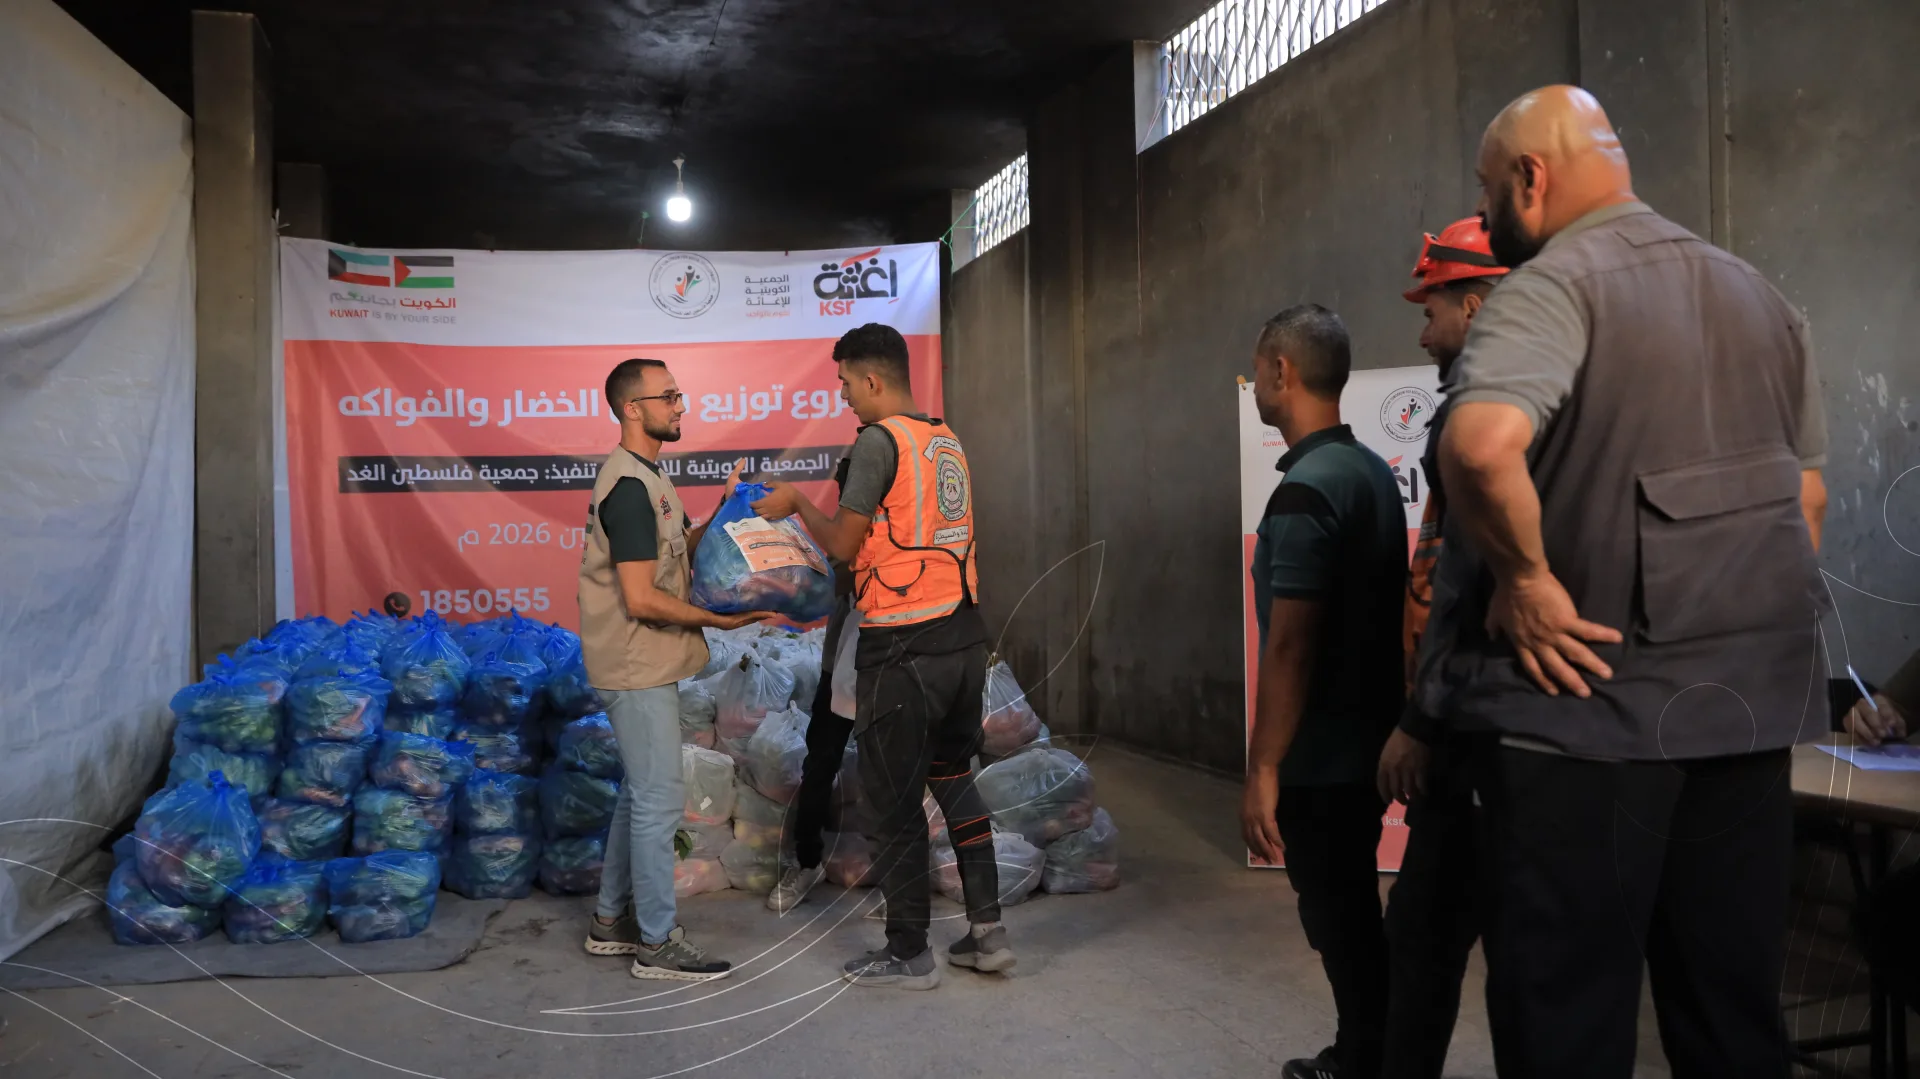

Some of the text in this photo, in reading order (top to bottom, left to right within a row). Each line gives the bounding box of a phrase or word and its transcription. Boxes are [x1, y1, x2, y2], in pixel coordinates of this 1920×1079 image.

[745, 274, 789, 285] الجمعية
[745, 285, 790, 296] الكويتية
[399, 297, 457, 311] الكويت
[745, 296, 791, 308] للإغاثة
[329, 309, 457, 325] KUWAIT IS BY YOUR SIDE
[338, 387, 489, 427] والفواكه
[497, 388, 599, 427] الخضار
[701, 384, 784, 424] توزيع
[346, 464, 385, 481] الغد
[391, 463, 473, 487] فلسطين
[479, 465, 538, 484] جمعية
[544, 463, 597, 484] تنفيذ:
[760, 453, 830, 476] الجمعية
[489, 522, 551, 545] 2026
[420, 587, 550, 615] 1850555
